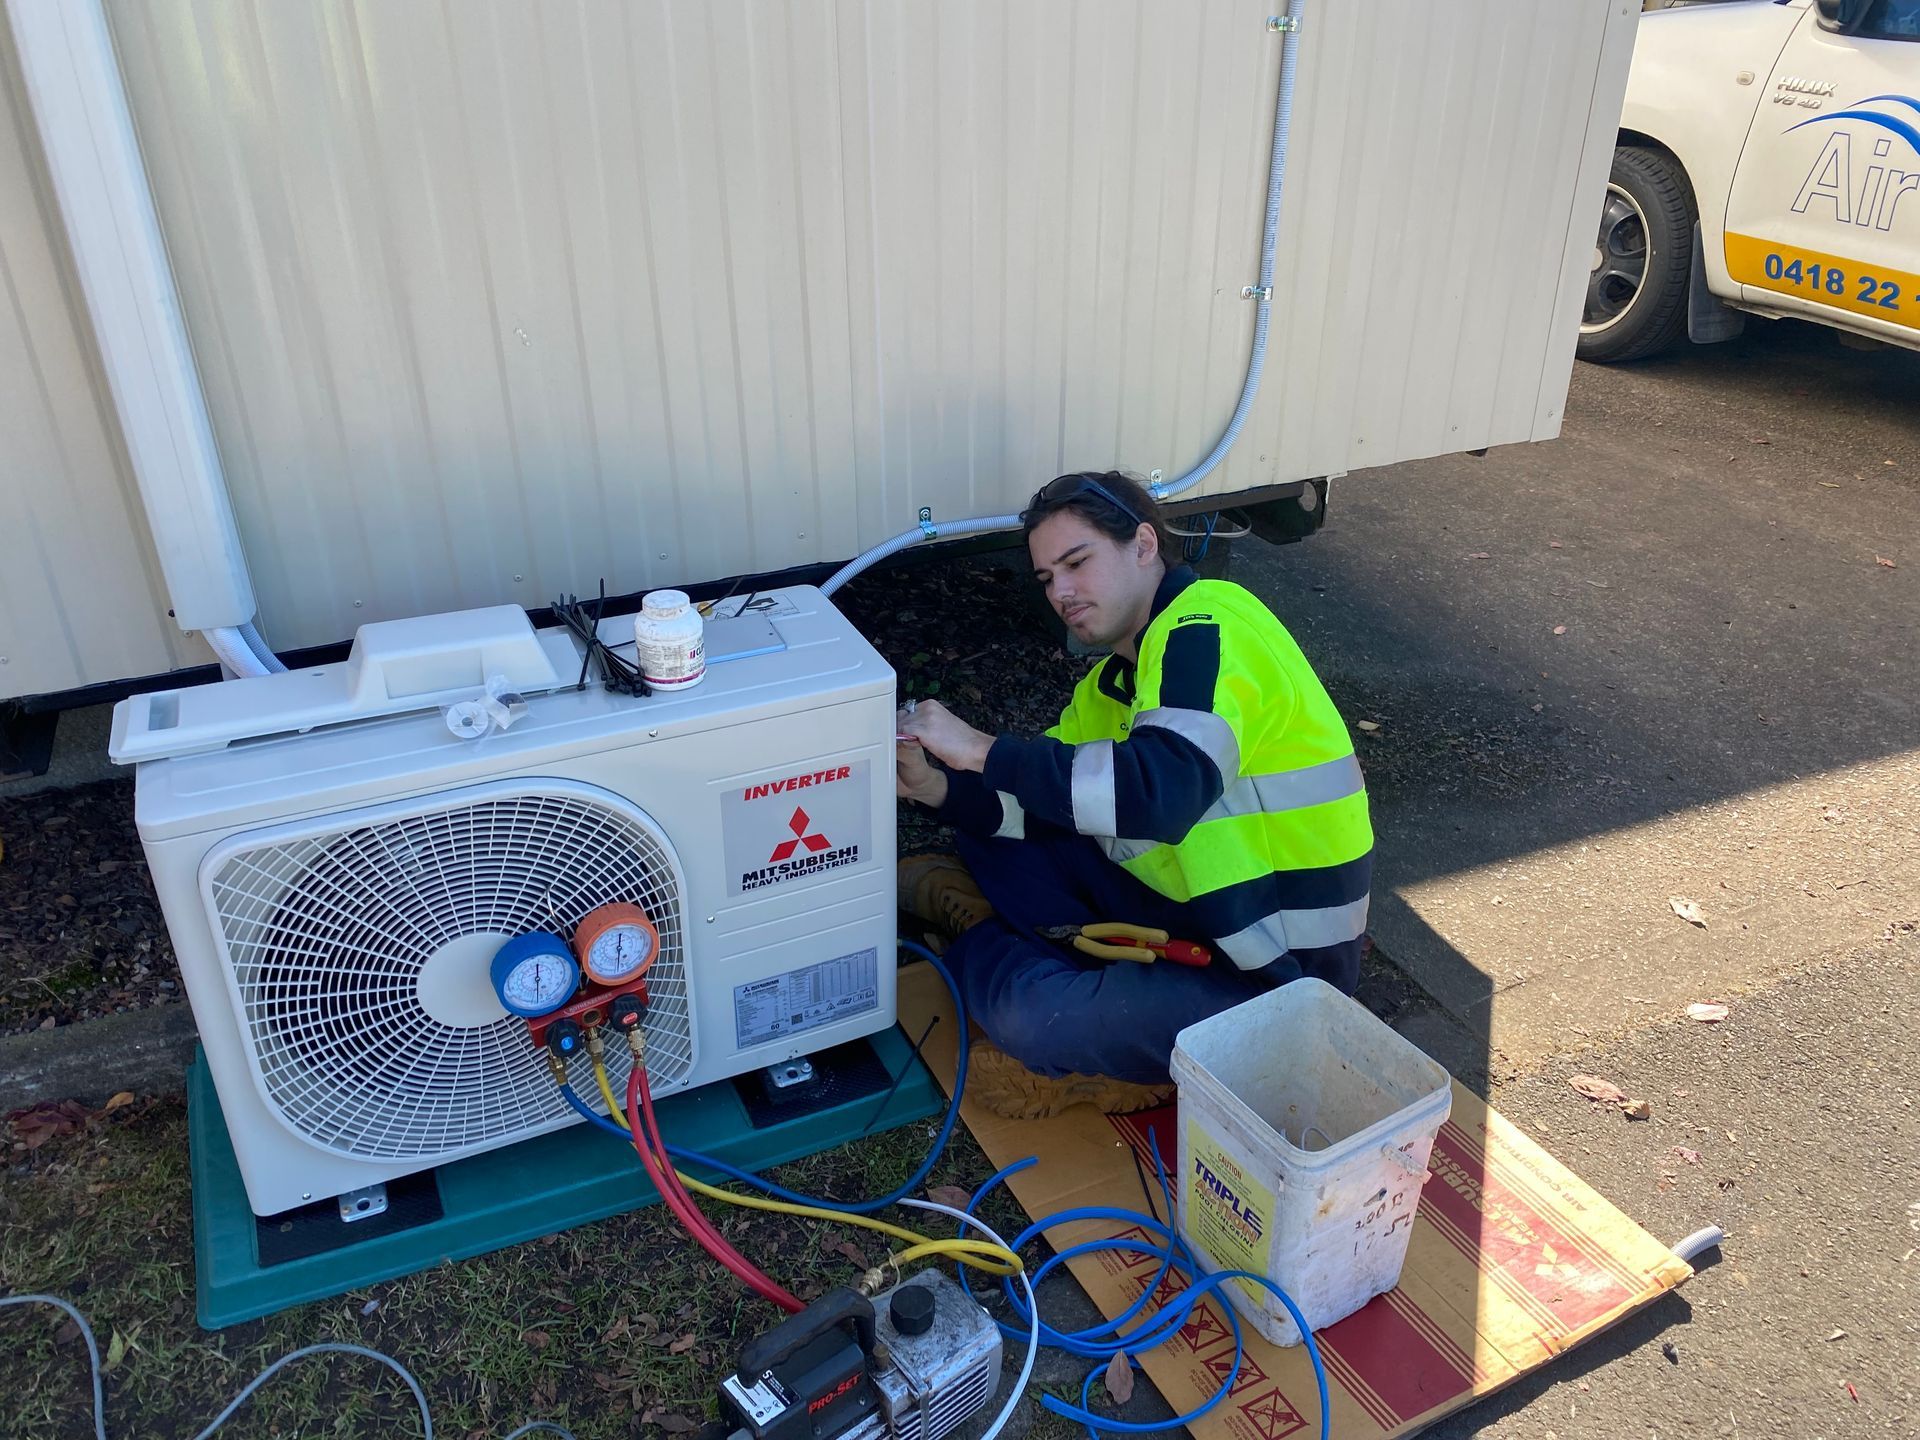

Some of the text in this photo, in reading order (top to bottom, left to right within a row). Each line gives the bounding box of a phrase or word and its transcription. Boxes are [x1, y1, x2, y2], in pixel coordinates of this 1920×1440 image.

[1778, 76, 1838, 97] HILUX
[1790, 131, 1920, 232] Air
[1764, 254, 1901, 310] 0418 22
[744, 766, 851, 801] INVERTER
[742, 845, 858, 884] MITSUBISHI
[742, 855, 858, 892] HEAVY INDUSTRIES
[1218, 1152, 1243, 1181] CAUTION
[1195, 1157, 1264, 1240] TRIPLE
[1195, 1179, 1261, 1244] ACTION
[1195, 1188, 1255, 1249] POOL CHLORINE
[1562, 1192, 1588, 1212] AIR
[808, 1372, 862, 1415] PRO-SET
